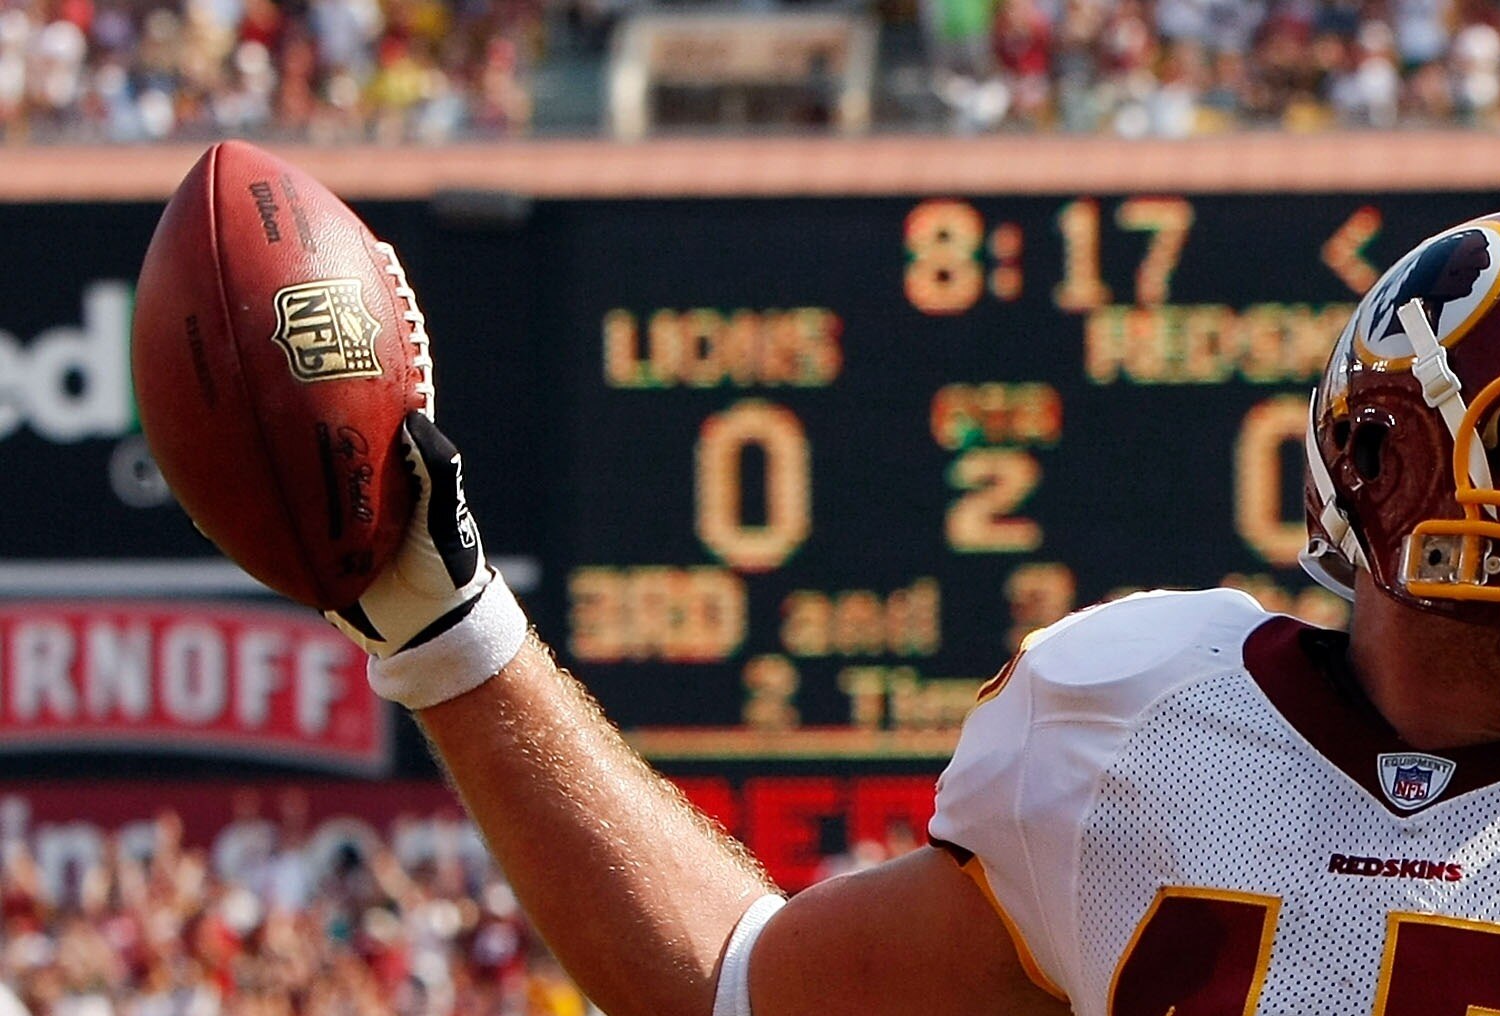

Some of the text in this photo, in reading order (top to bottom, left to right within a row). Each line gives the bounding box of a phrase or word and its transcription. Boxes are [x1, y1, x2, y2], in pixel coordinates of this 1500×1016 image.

[249, 179, 282, 245] Wilson
[902, 197, 1196, 315] 8:17
[285, 288, 346, 372] NFL
[695, 398, 812, 571] 0
[946, 448, 1044, 554] 2
[1384, 757, 1448, 774] EQUIPMENT
[1394, 780, 1428, 801] NFL
[1328, 853, 1463, 882] REDSKINS
